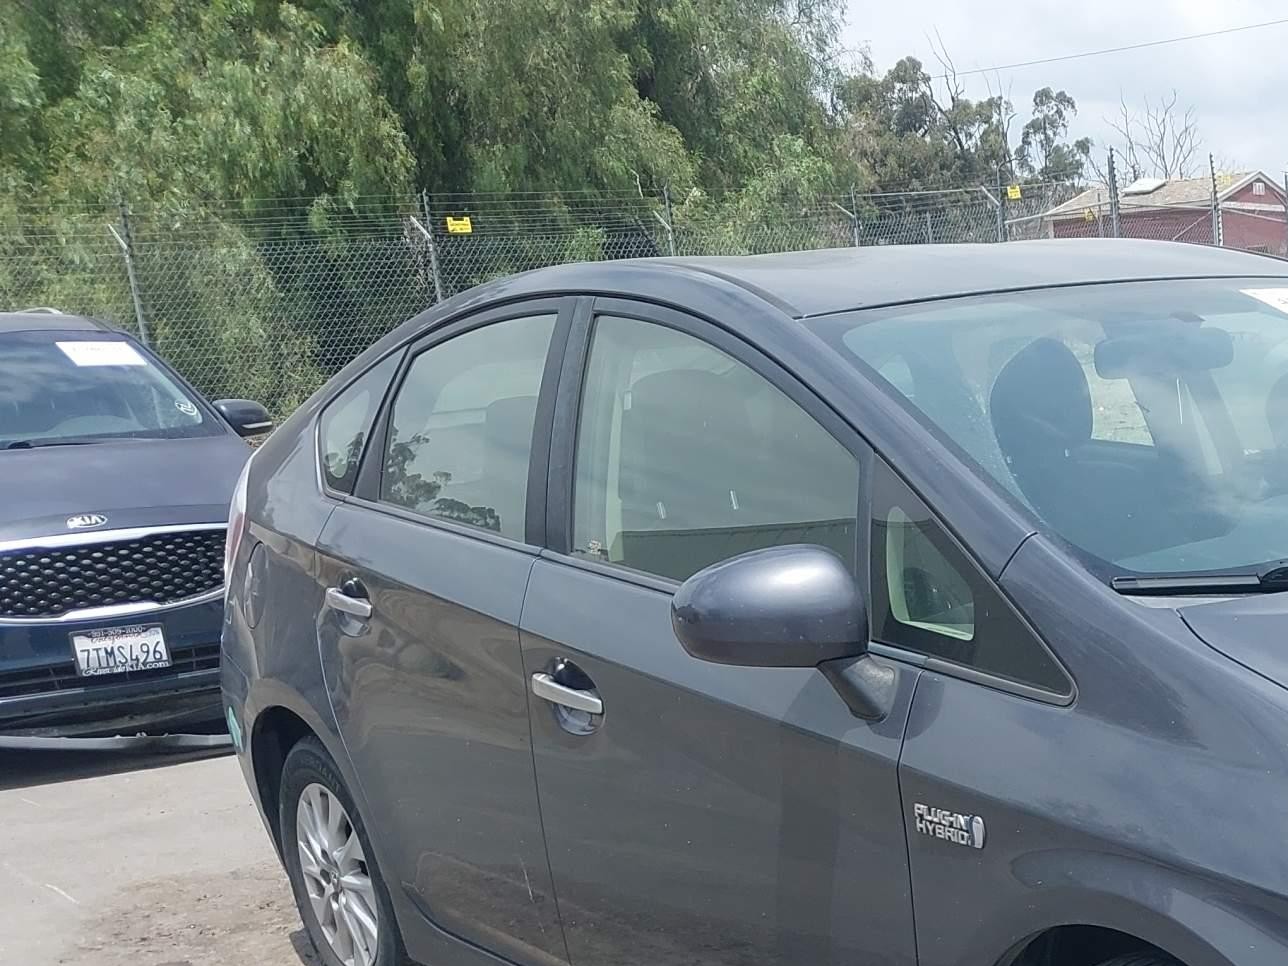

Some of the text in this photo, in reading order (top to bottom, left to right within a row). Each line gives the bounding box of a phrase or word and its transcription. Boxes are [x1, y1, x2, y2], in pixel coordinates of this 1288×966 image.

[72, 515, 105, 527] KIA
[80, 641, 164, 669] 7TMS496
[914, 803, 968, 830] PLUG-IN
[916, 818, 968, 845] HYBRID
